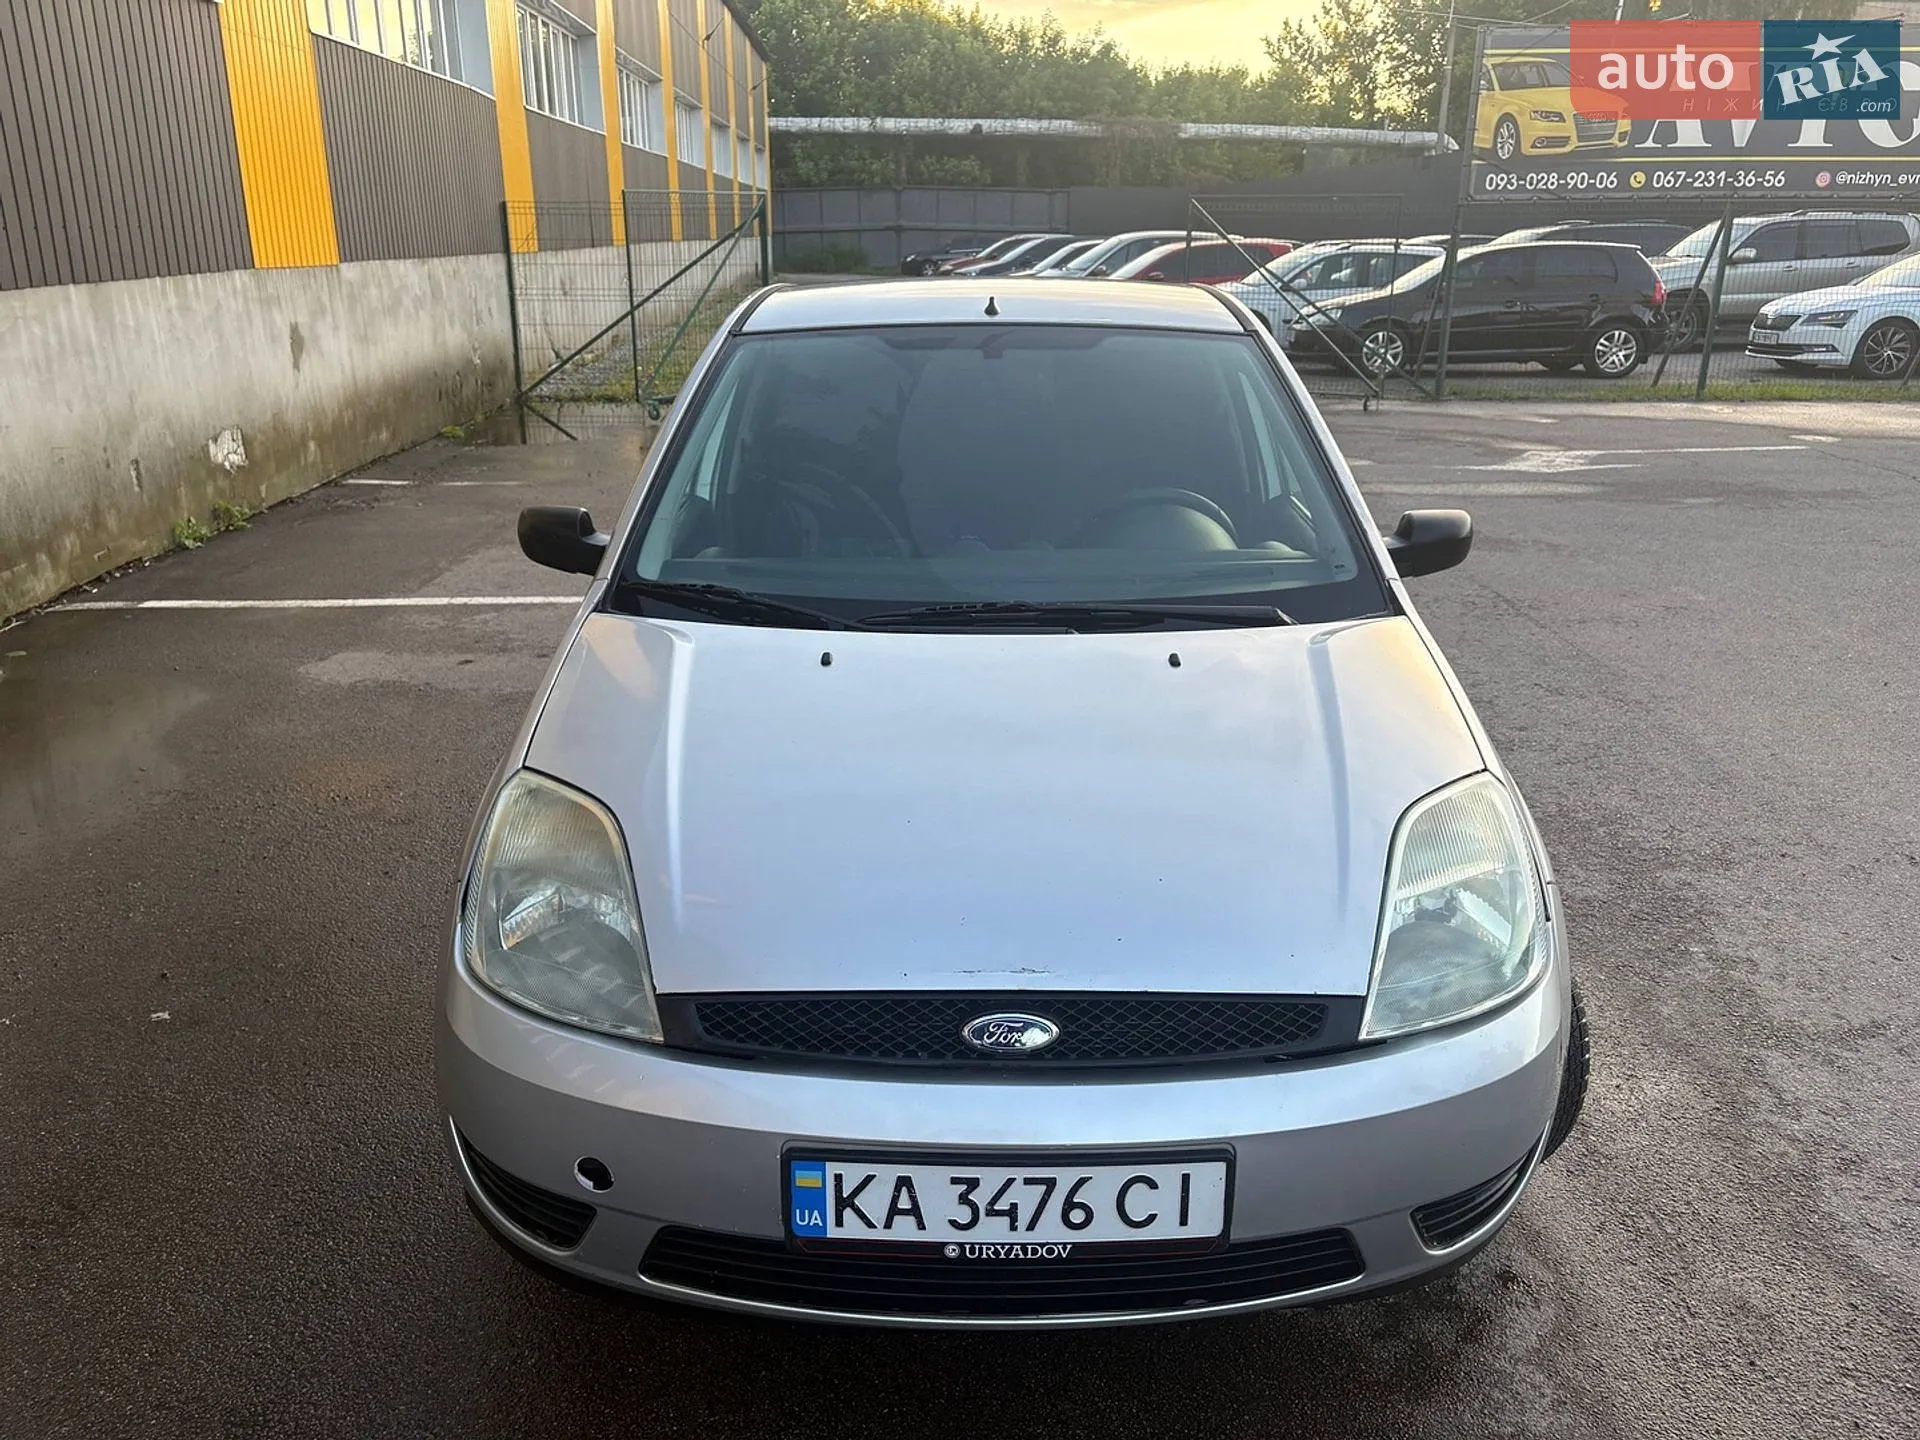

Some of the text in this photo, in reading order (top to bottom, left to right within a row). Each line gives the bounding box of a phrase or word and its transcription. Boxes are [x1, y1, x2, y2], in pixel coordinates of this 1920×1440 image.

[1485, 171, 1617, 191] 093-028-90-06
[1652, 170, 1785, 188] 067-231-36-56
[834, 1173, 926, 1230] KA
[948, 1175, 1094, 1232] 3476
[796, 1209, 823, 1226] UA
[964, 1244, 1072, 1258] URYADOV
